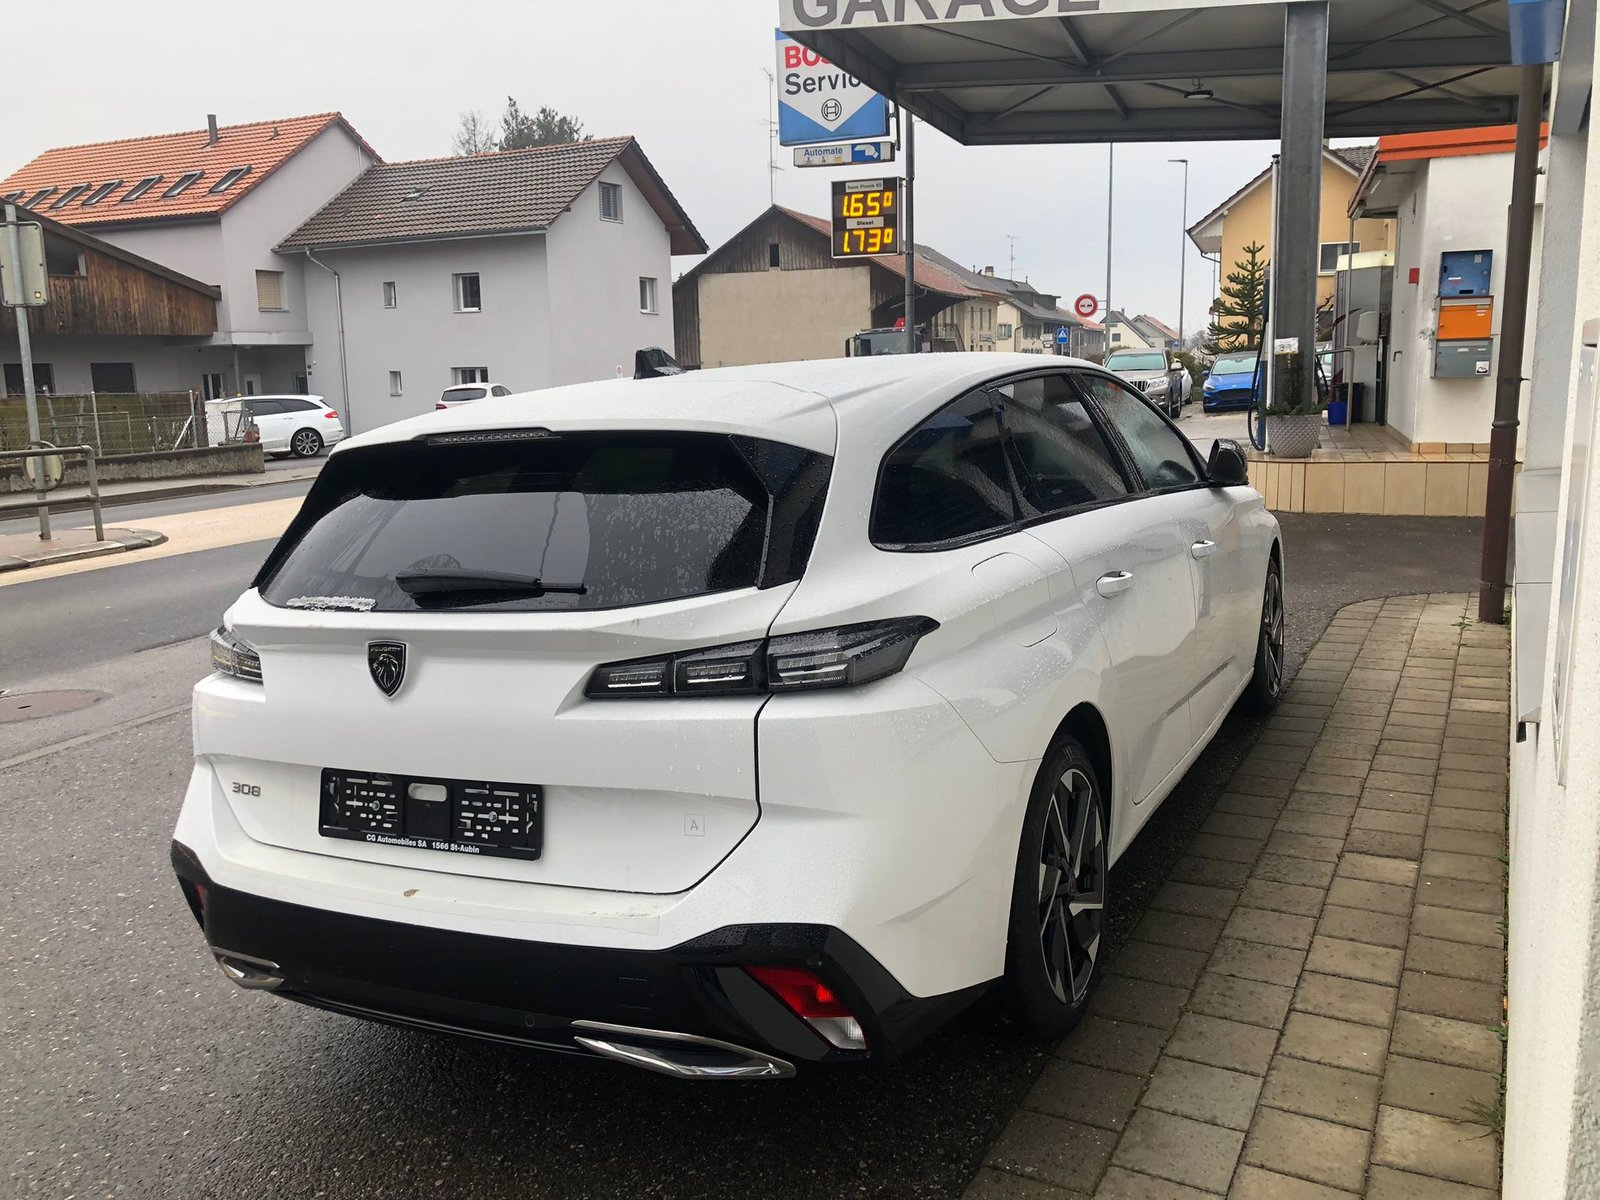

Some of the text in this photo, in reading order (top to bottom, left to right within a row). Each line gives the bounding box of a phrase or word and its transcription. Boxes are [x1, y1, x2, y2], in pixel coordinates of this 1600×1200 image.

[793, 0, 1100, 27] GAA
[804, 147, 843, 157] Automate
[232, 782, 261, 797] 308
[366, 834, 480, 853] CG Automobiles SA 1566 St-Aubin
